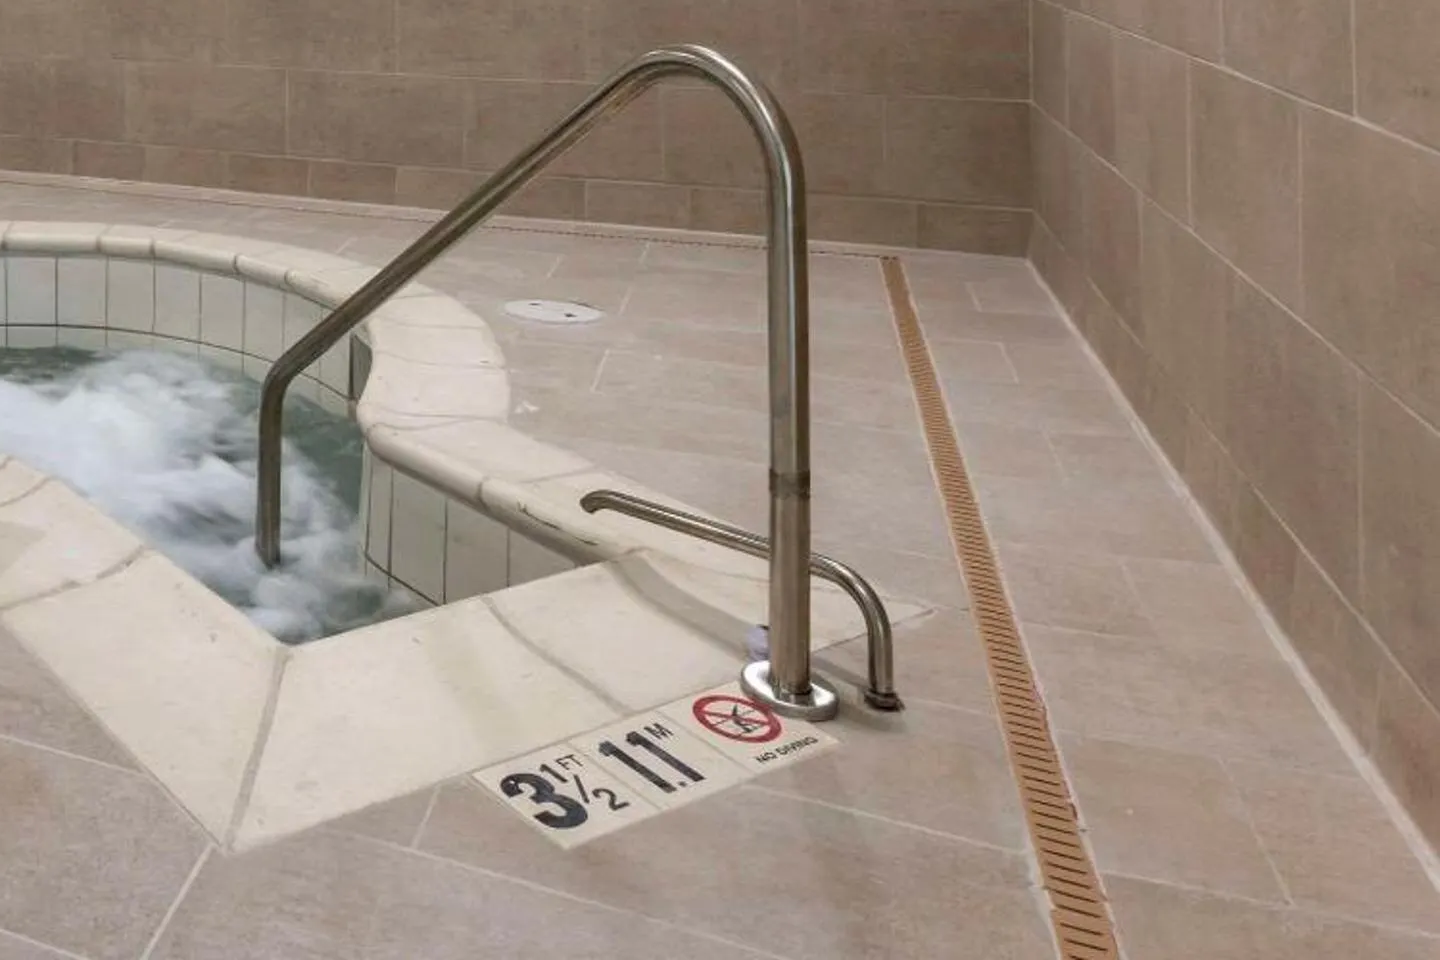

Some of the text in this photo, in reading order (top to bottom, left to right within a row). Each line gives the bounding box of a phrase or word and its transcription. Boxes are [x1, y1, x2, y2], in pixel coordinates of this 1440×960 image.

[555, 753, 585, 771] FT
[598, 722, 706, 794] 1.1 M
[756, 736, 819, 764] NO DIVING
